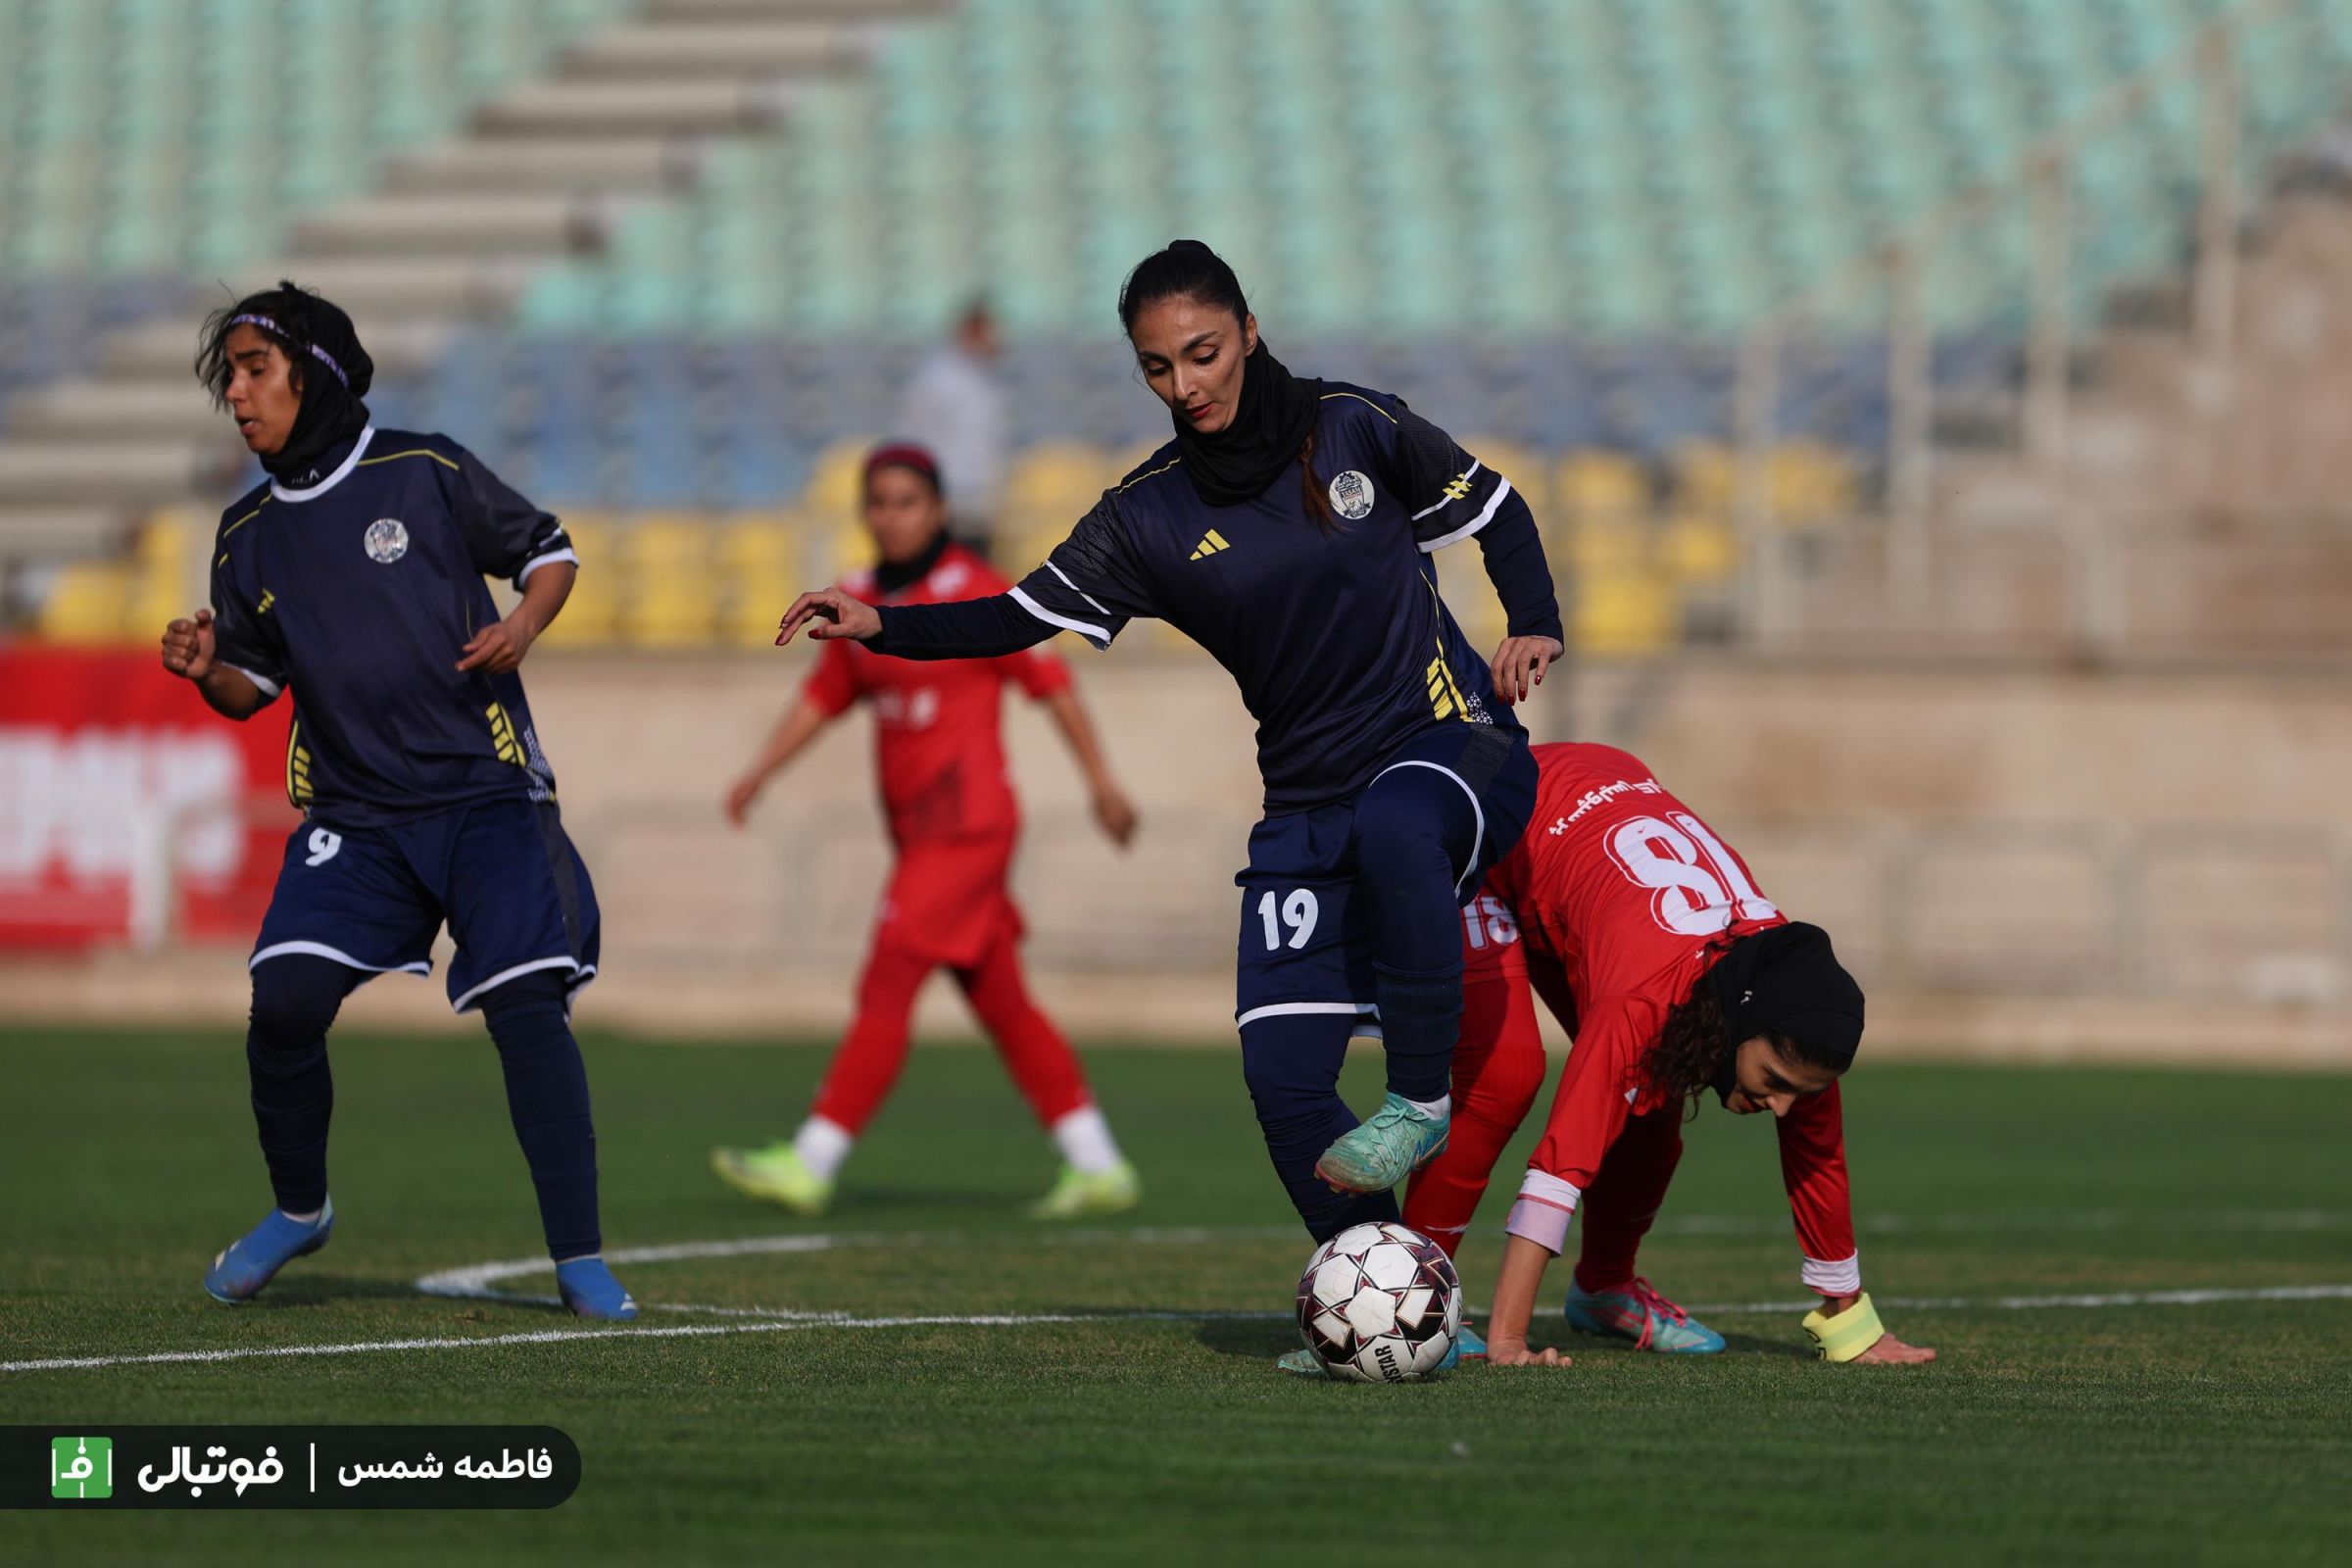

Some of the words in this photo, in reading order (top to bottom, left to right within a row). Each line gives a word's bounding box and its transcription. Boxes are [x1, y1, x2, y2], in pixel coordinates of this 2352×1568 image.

[306, 828, 341, 865] 9
[1604, 811, 1777, 937] 18
[1258, 889, 1318, 951] 19
